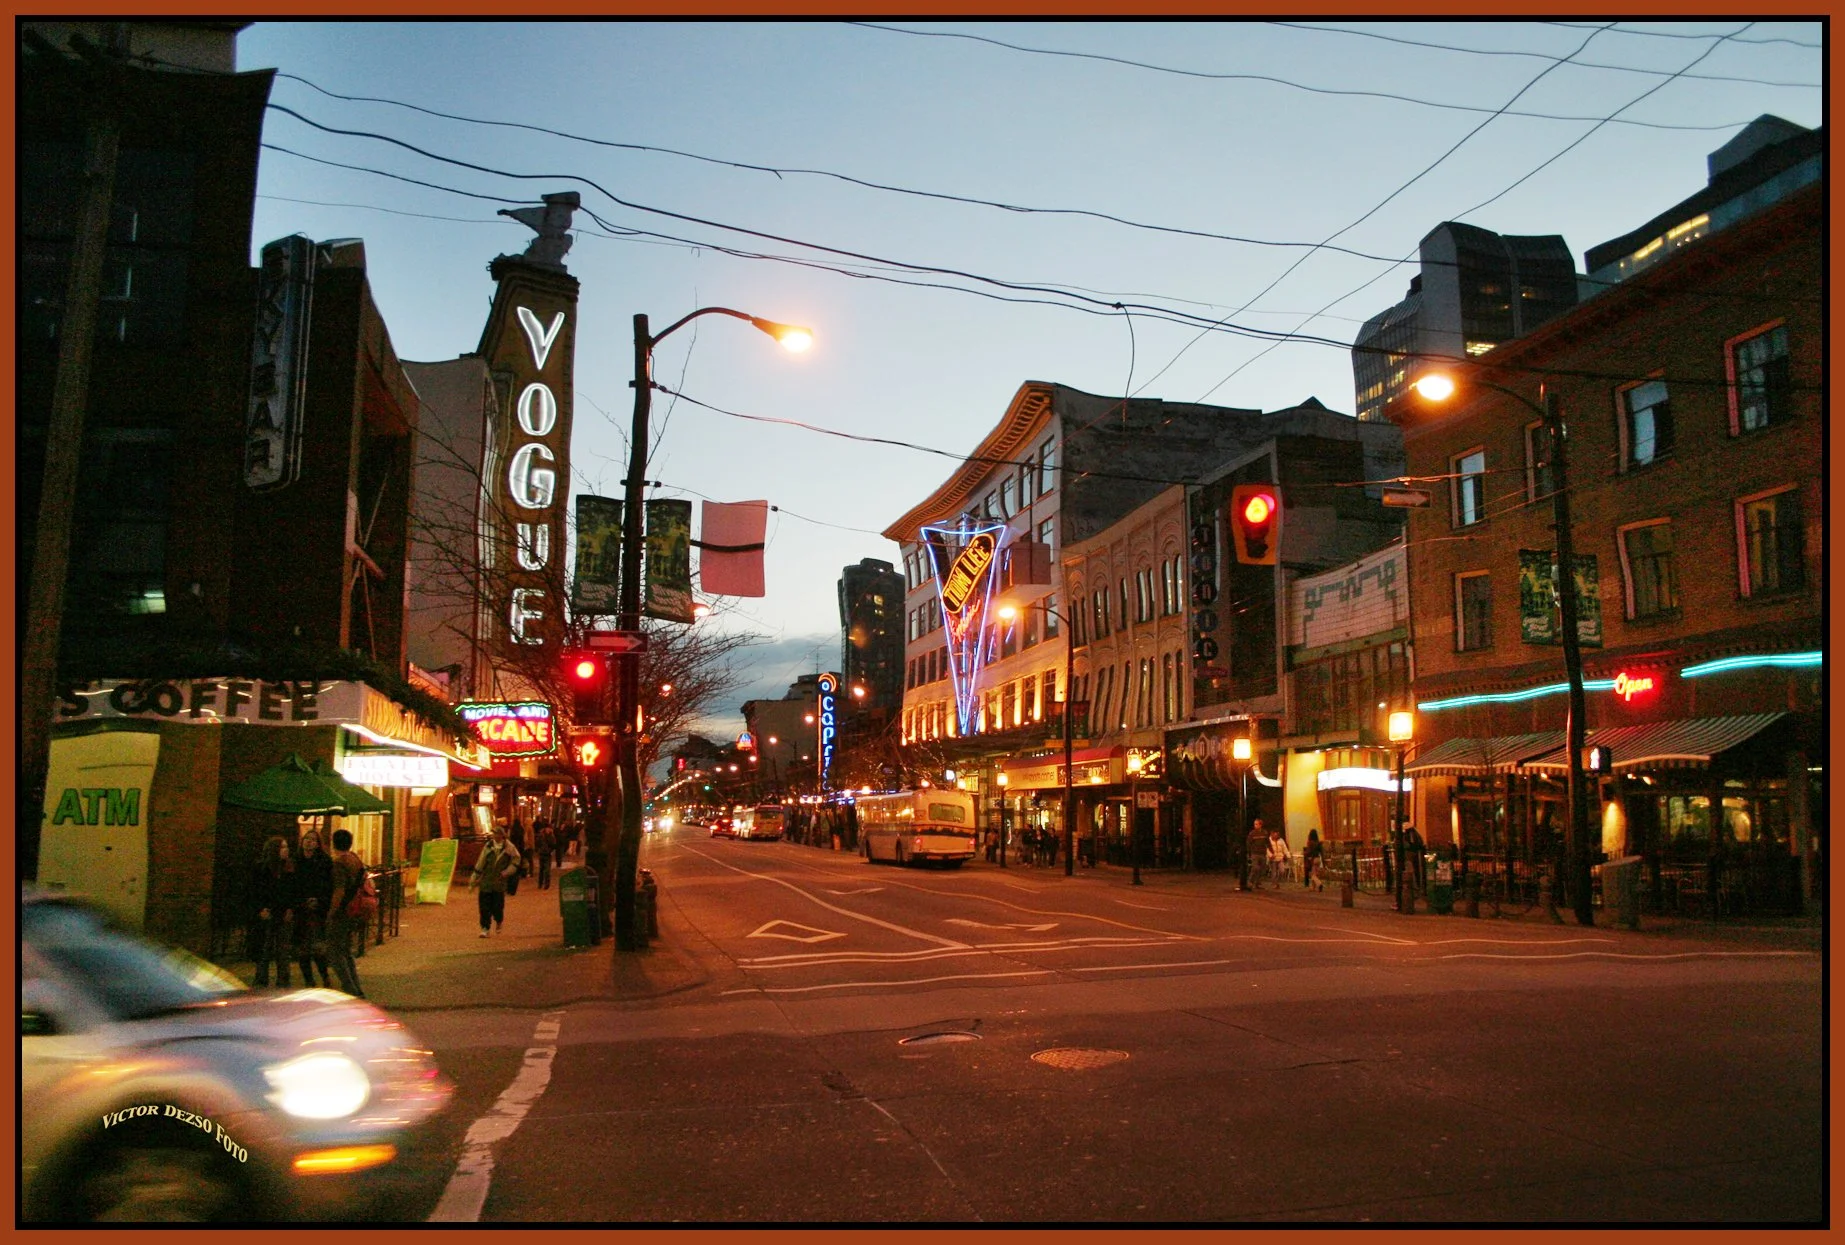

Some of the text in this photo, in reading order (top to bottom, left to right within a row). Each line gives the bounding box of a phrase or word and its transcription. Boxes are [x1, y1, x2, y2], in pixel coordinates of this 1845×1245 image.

[509, 306, 565, 645] VOGUE
[944, 540, 990, 607] TOM LEE
[110, 681, 319, 721] COFFEE
[1615, 672, 1653, 701] Open
[476, 718, 549, 743] RCADE
[53, 788, 141, 827] ATM
